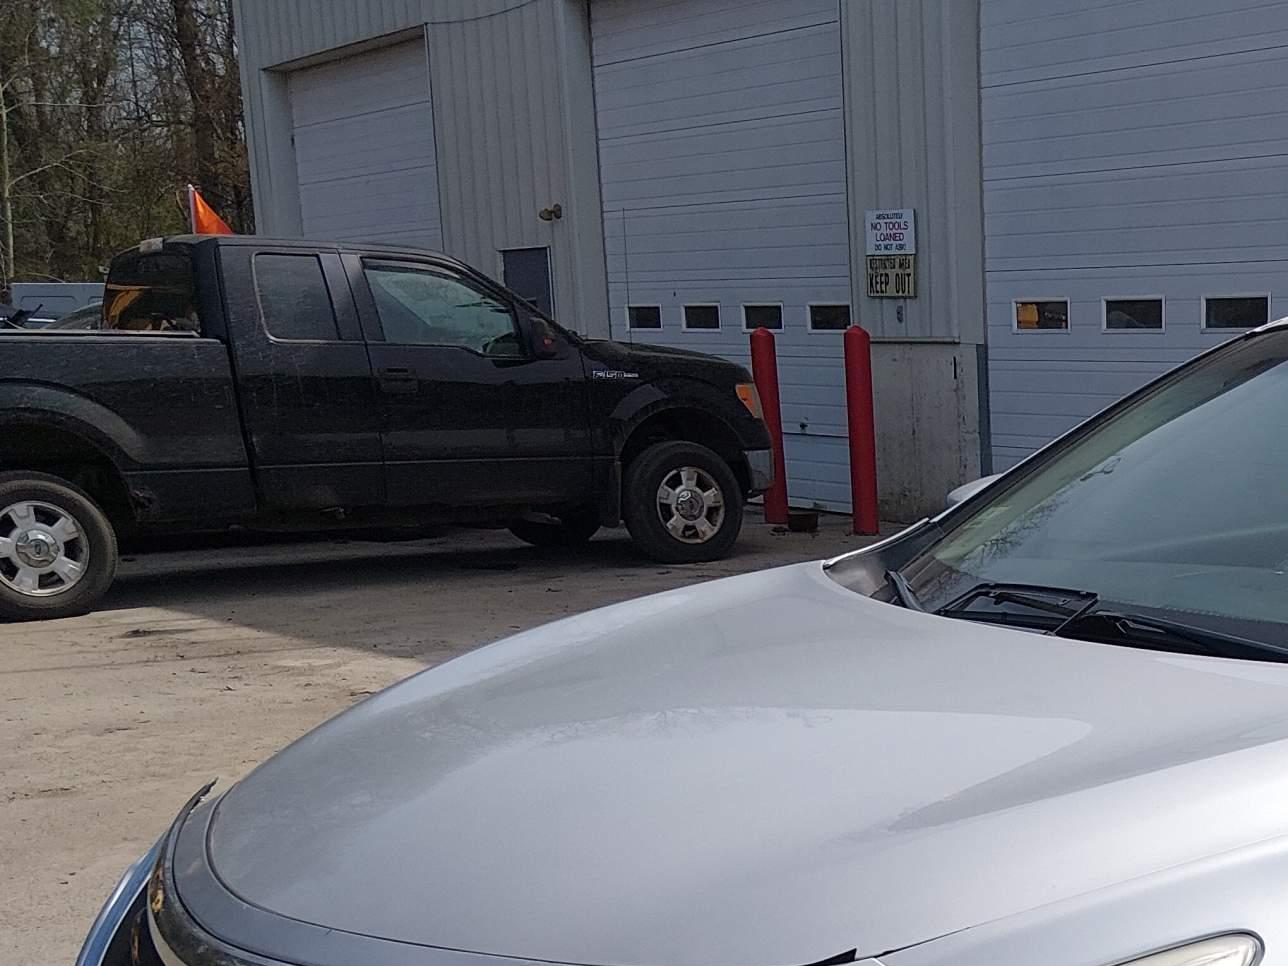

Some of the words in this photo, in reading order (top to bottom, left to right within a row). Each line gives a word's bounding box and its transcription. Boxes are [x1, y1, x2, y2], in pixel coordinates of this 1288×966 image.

[870, 222, 882, 232] NO
[884, 221, 909, 231] TOOLS
[875, 232, 905, 242] LOANED
[874, 243, 882, 251] DO
[883, 243, 894, 251] NOT
[898, 258, 911, 271] AREA
[869, 273, 890, 294] KEEP
[895, 272, 912, 294] OUT
